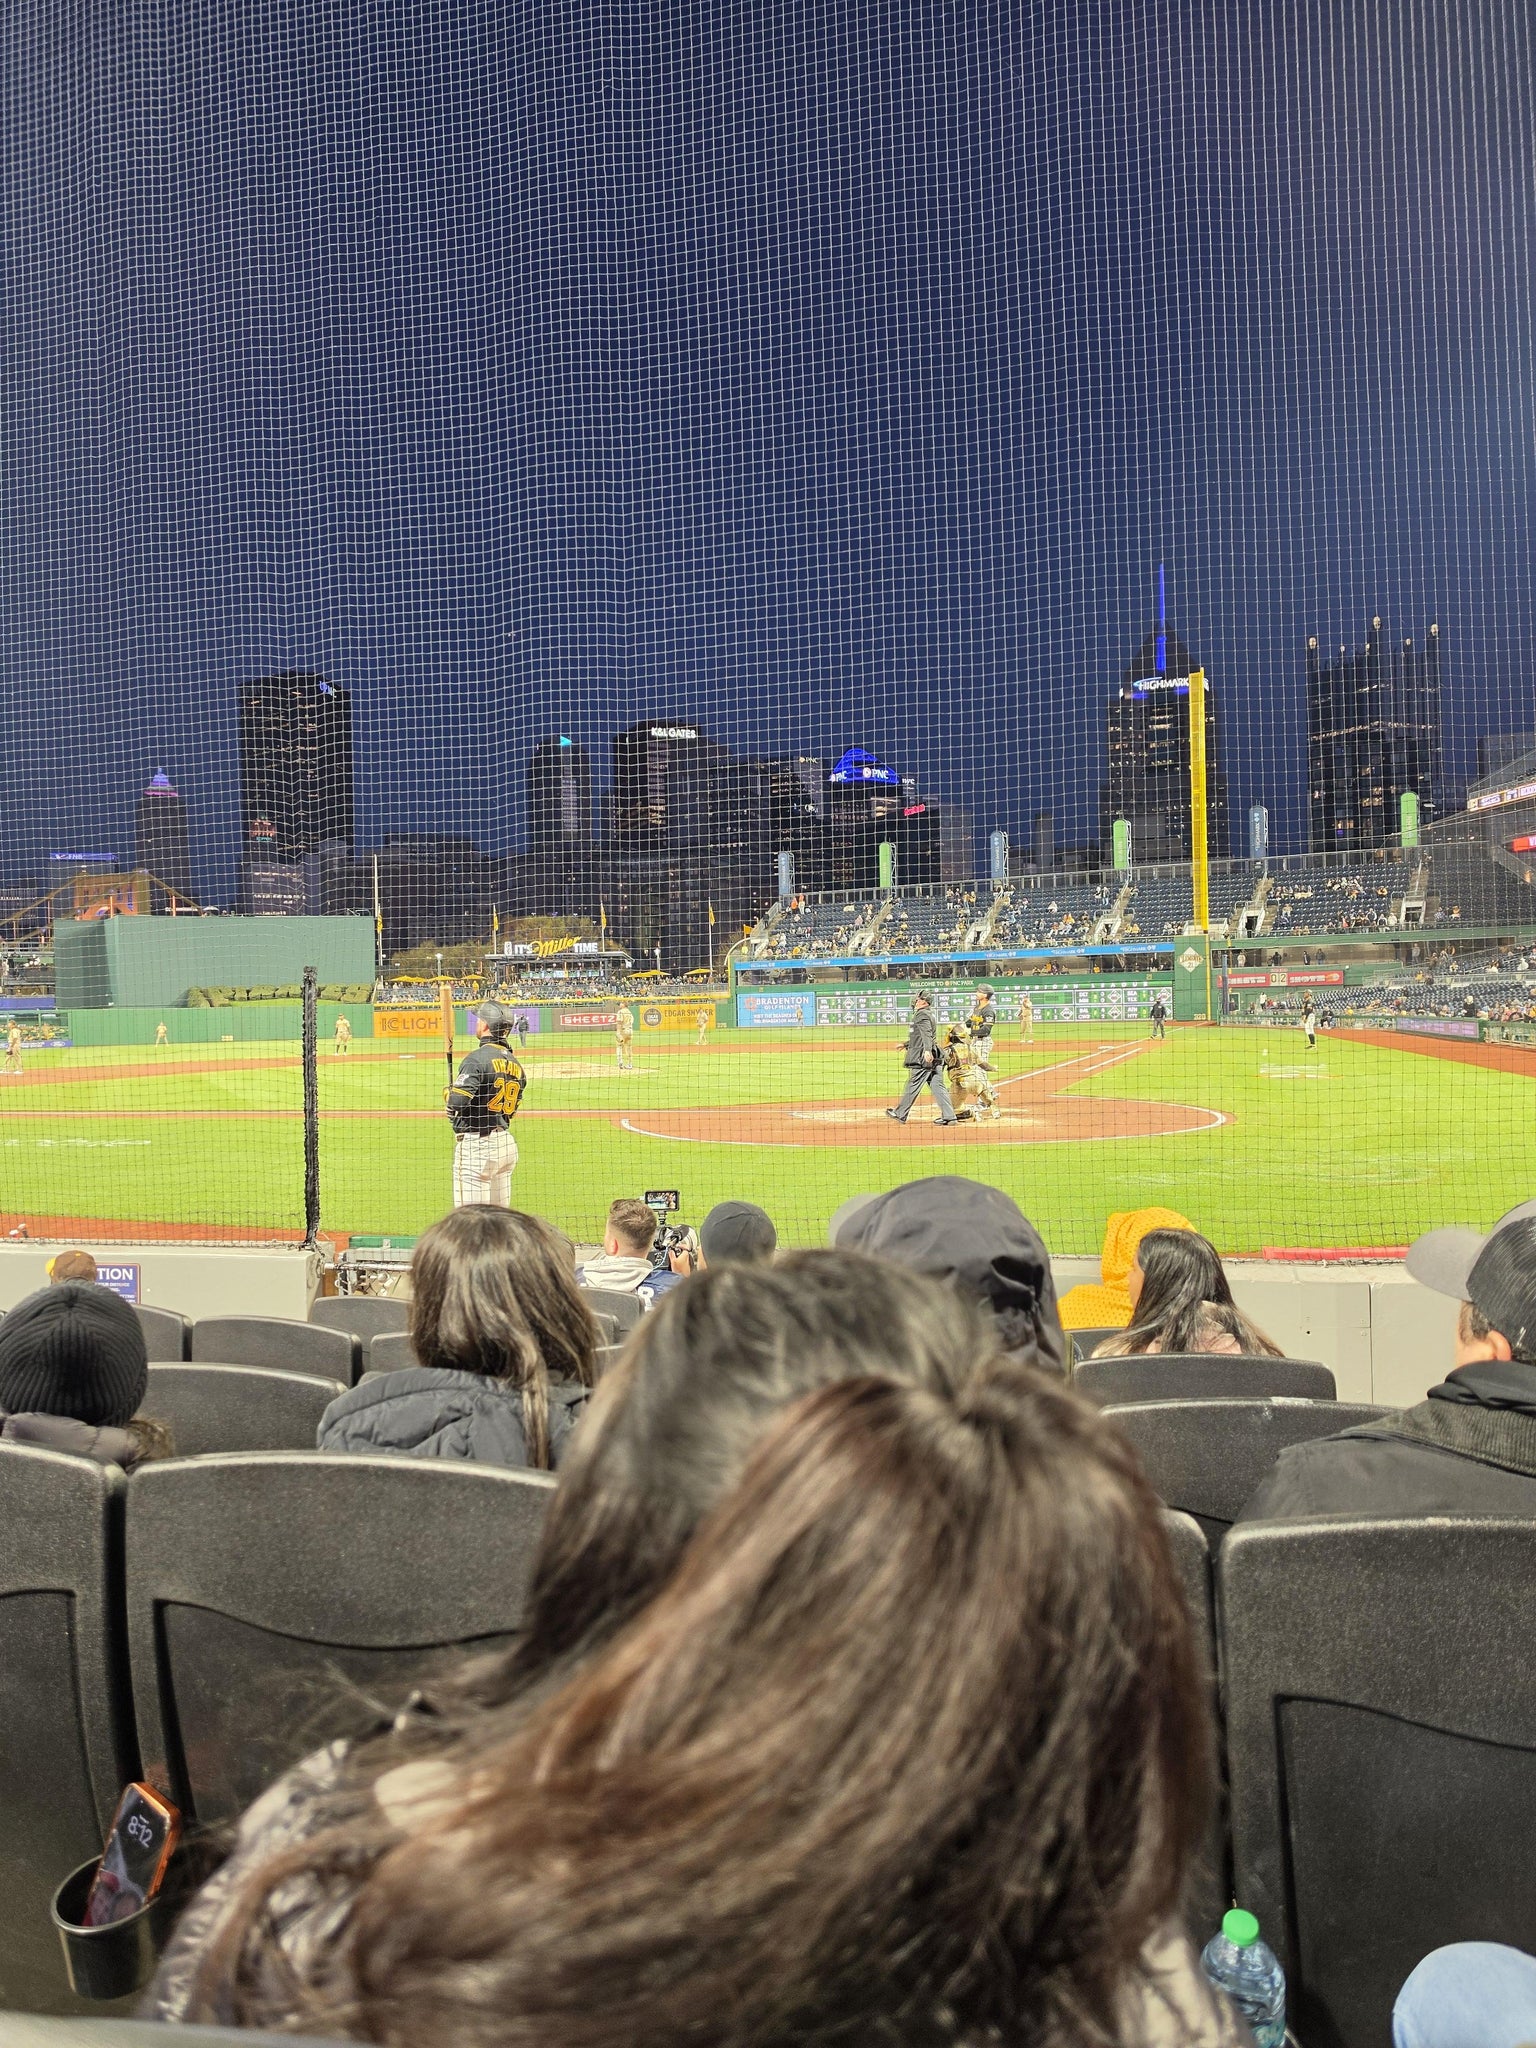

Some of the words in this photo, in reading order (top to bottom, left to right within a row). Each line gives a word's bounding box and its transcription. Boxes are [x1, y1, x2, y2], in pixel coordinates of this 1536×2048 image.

[1138, 678, 1189, 690] HIGHMARK
[651, 727, 668, 737] K&L
[668, 728, 696, 738] GATES
[871, 769, 889, 779] PNC
[514, 944, 533, 954] IT'S
[530, 936, 581, 959] Miller
[574, 942, 598, 953] TIME
[756, 996, 809, 1005] BRADENTON
[402, 1017, 442, 1030] LIGH
[564, 1015, 616, 1024] SHEETZ
[487, 1077, 521, 1116] 29
[96, 1268, 133, 1280] TION
[128, 1815, 153, 1848] 8:12
